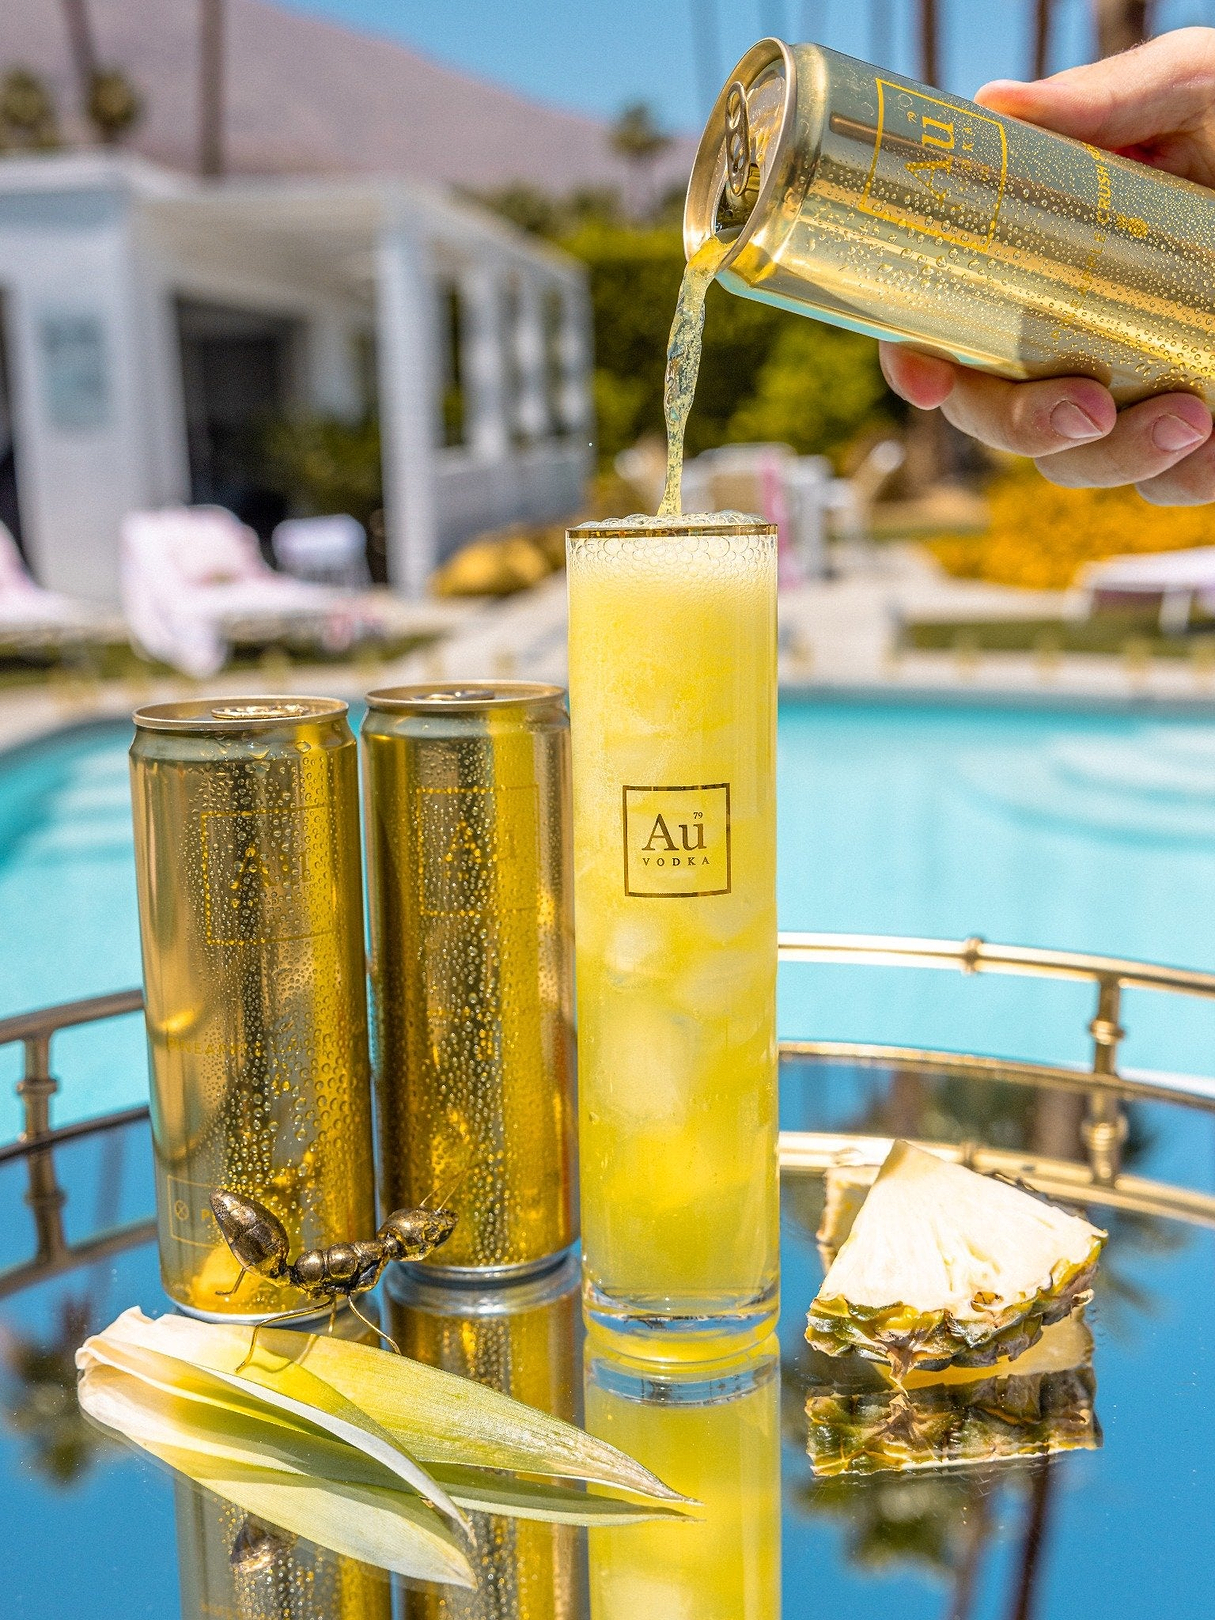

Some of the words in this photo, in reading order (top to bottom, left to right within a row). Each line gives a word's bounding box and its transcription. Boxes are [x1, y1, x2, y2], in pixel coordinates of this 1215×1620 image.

[904, 116, 955, 206] Au
[1095, 164, 1111, 224] CRUSH
[641, 813, 707, 851] Au
[693, 811, 704, 820] 79
[642, 856, 710, 867] VODKA
